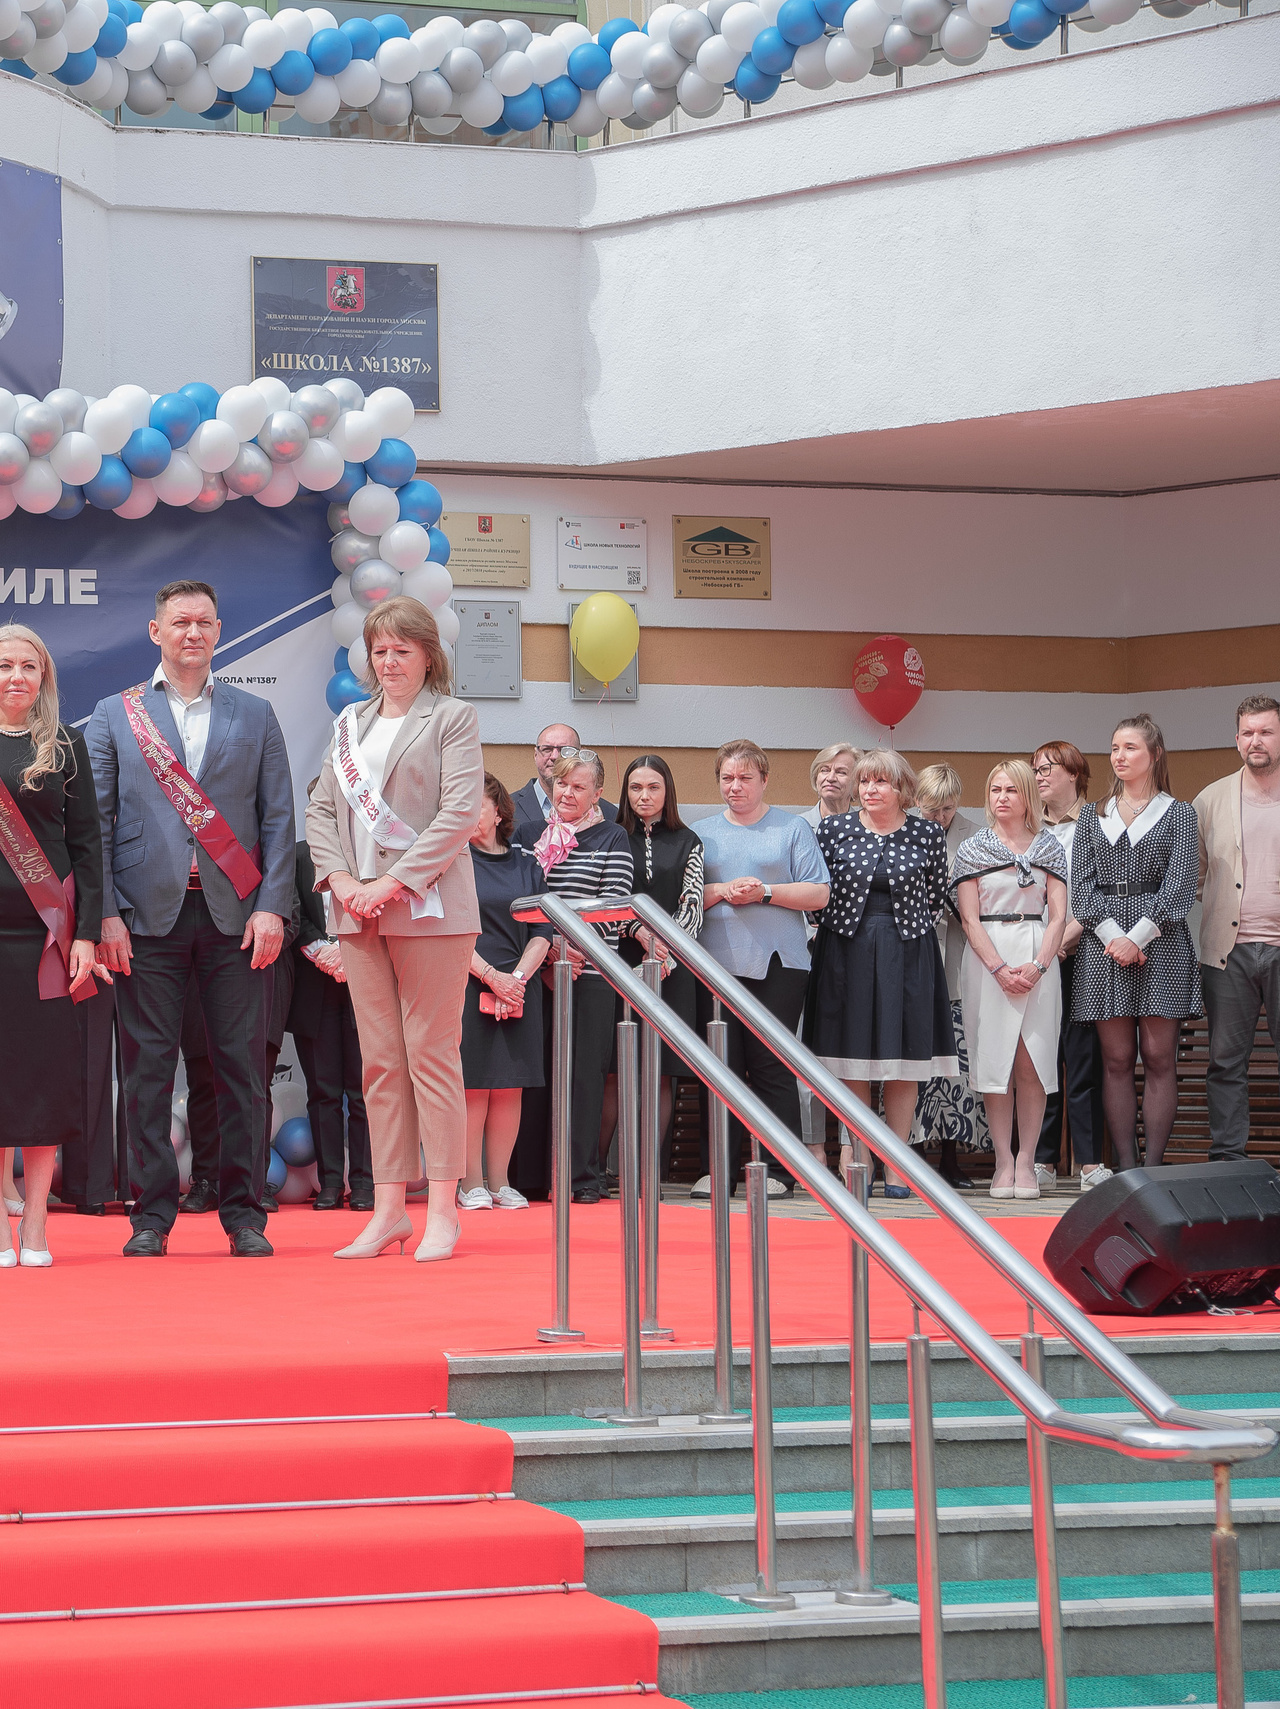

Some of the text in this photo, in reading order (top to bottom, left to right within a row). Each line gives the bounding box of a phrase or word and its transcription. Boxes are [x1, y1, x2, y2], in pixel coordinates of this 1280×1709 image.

[261, 352, 432, 375] «ШКОЛА №1387»
[690, 542, 751, 557] GB
[214, 676, 243, 684] КОЛА
[142, 742, 202, 806] руководитель
[357, 789, 380, 822] 2023
[16, 847, 52, 884] 2023
